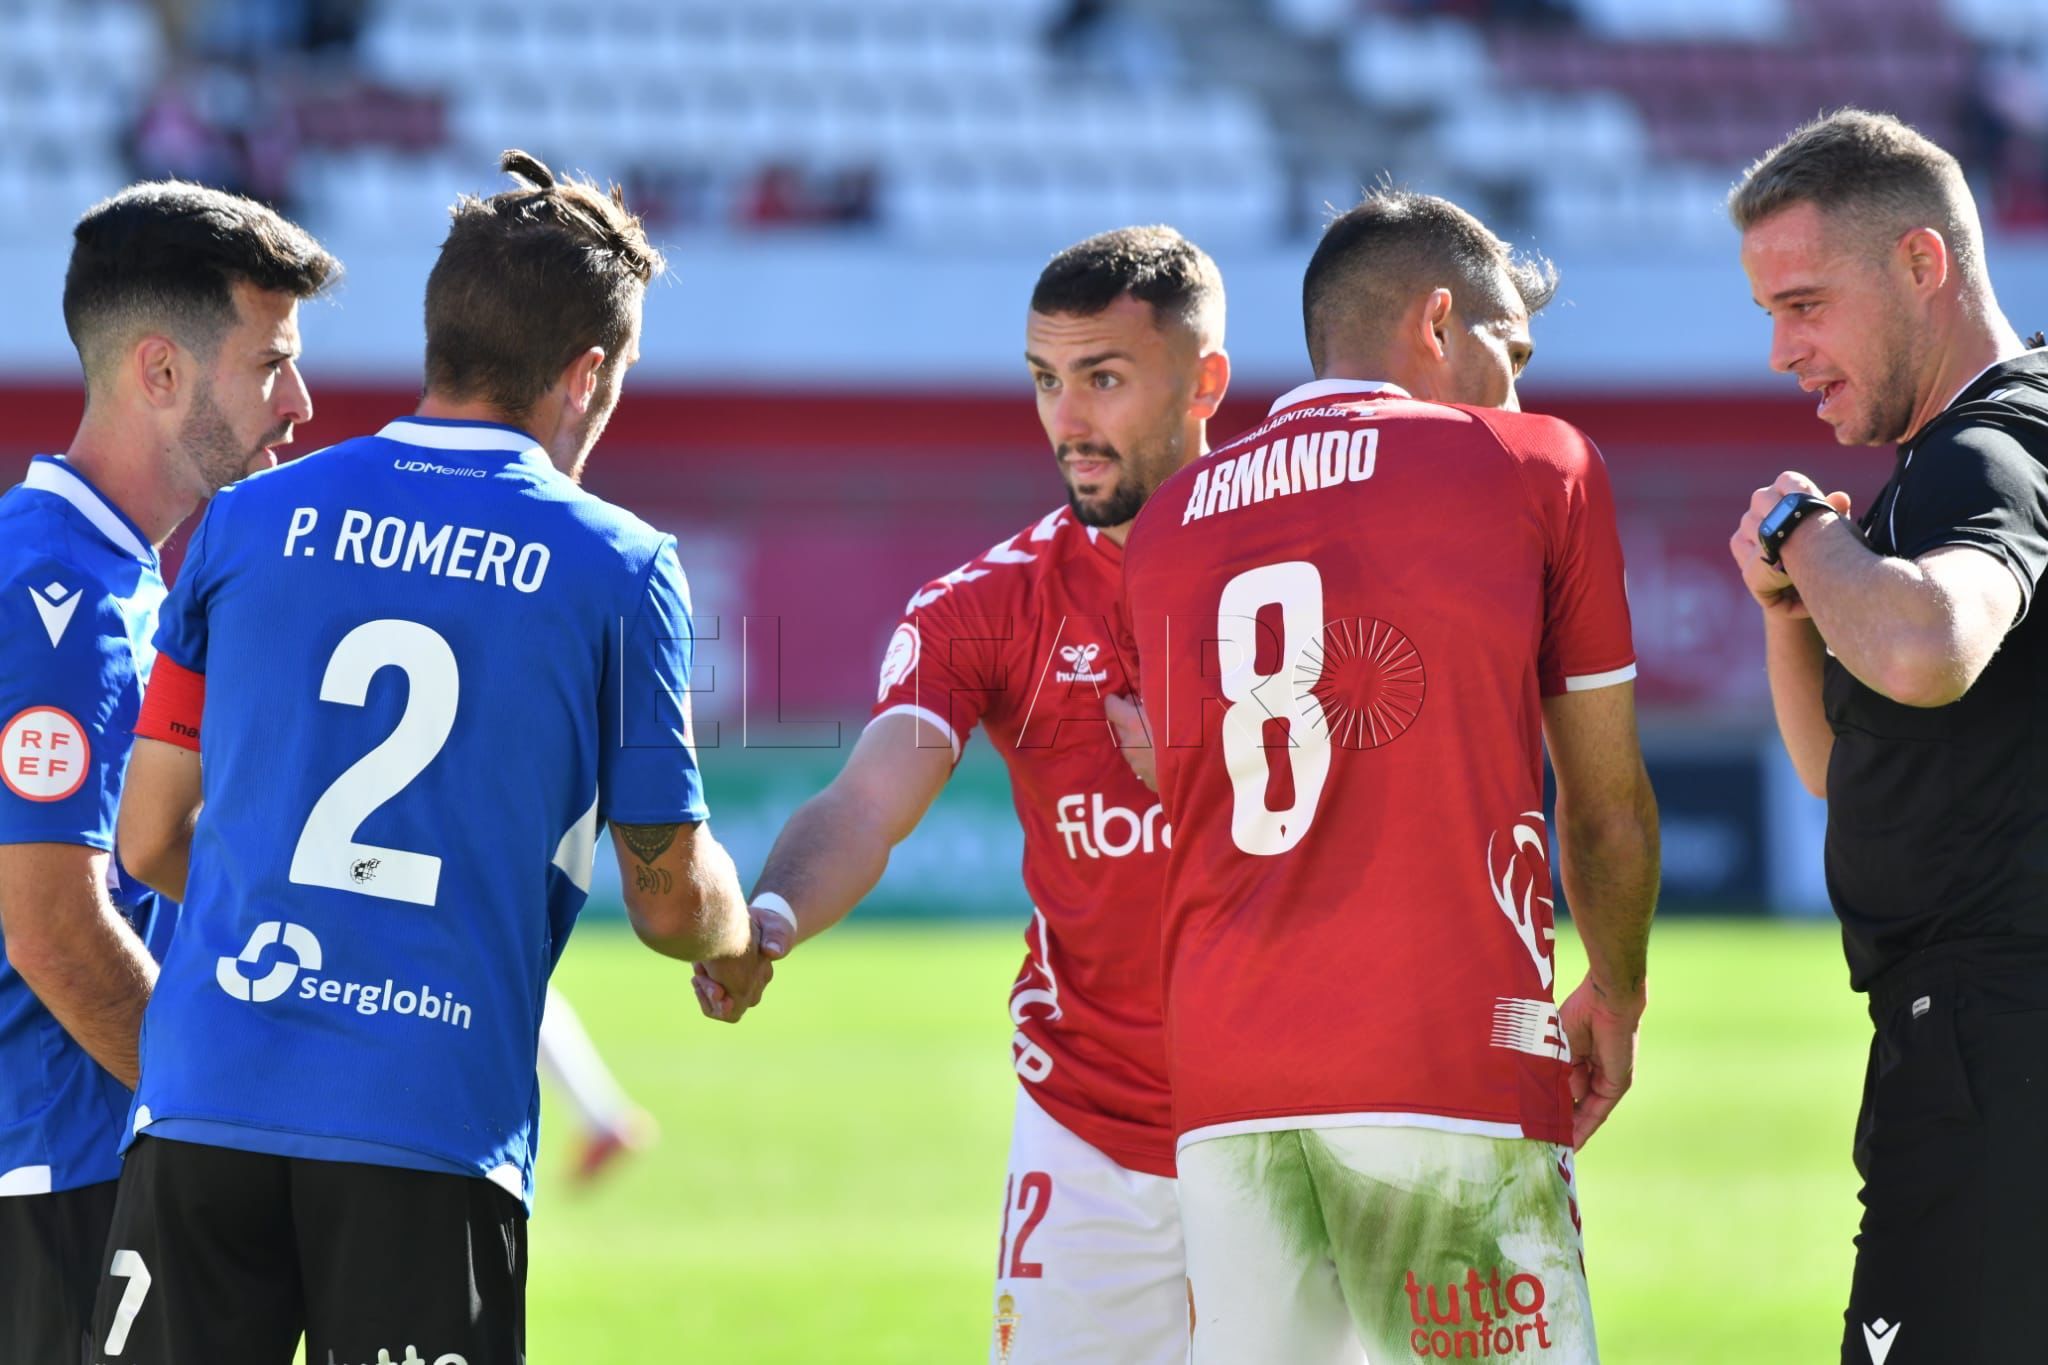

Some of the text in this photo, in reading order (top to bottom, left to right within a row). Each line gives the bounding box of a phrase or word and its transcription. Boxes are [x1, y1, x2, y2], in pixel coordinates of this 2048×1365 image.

[393, 459, 487, 478] UDMelilla
[1181, 428, 1379, 526] ARMANDO
[283, 507, 550, 593] P. ROMERO
[1217, 561, 1332, 856] 8
[288, 618, 460, 907] 2
[298, 976, 472, 1029] serglobin
[1404, 1265, 1545, 1326] tutto
[1411, 1313, 1552, 1359] confort
